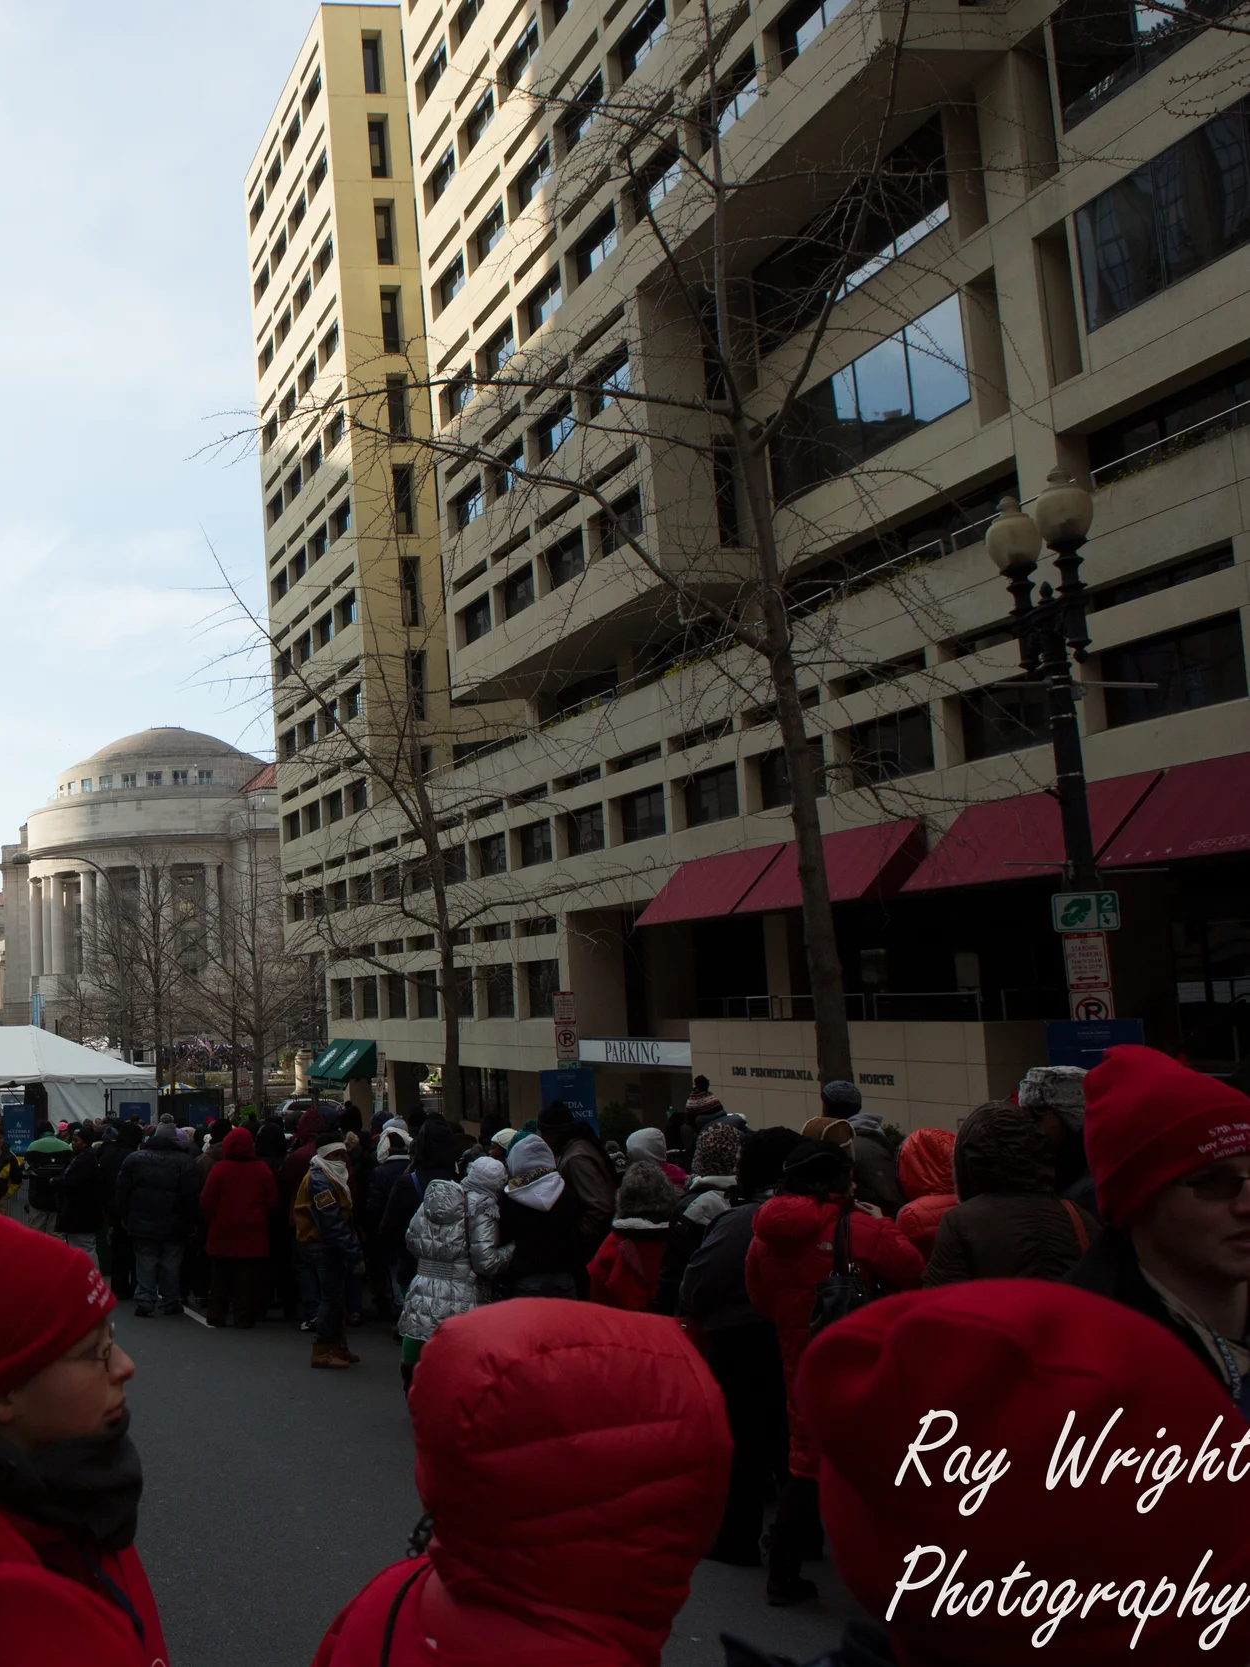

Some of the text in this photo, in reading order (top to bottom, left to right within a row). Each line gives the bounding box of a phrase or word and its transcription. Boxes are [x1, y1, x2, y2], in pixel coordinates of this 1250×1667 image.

[1101, 896, 1114, 909] 2
[605, 1041, 661, 1064] PARKING
[732, 1066, 895, 1086] 1301 PENNSYLVANIA NORTH
[563, 1101, 584, 1109] DIA
[1208, 1124, 1231, 1138] 57th
[1198, 1133, 1246, 1154] Boy Scout
